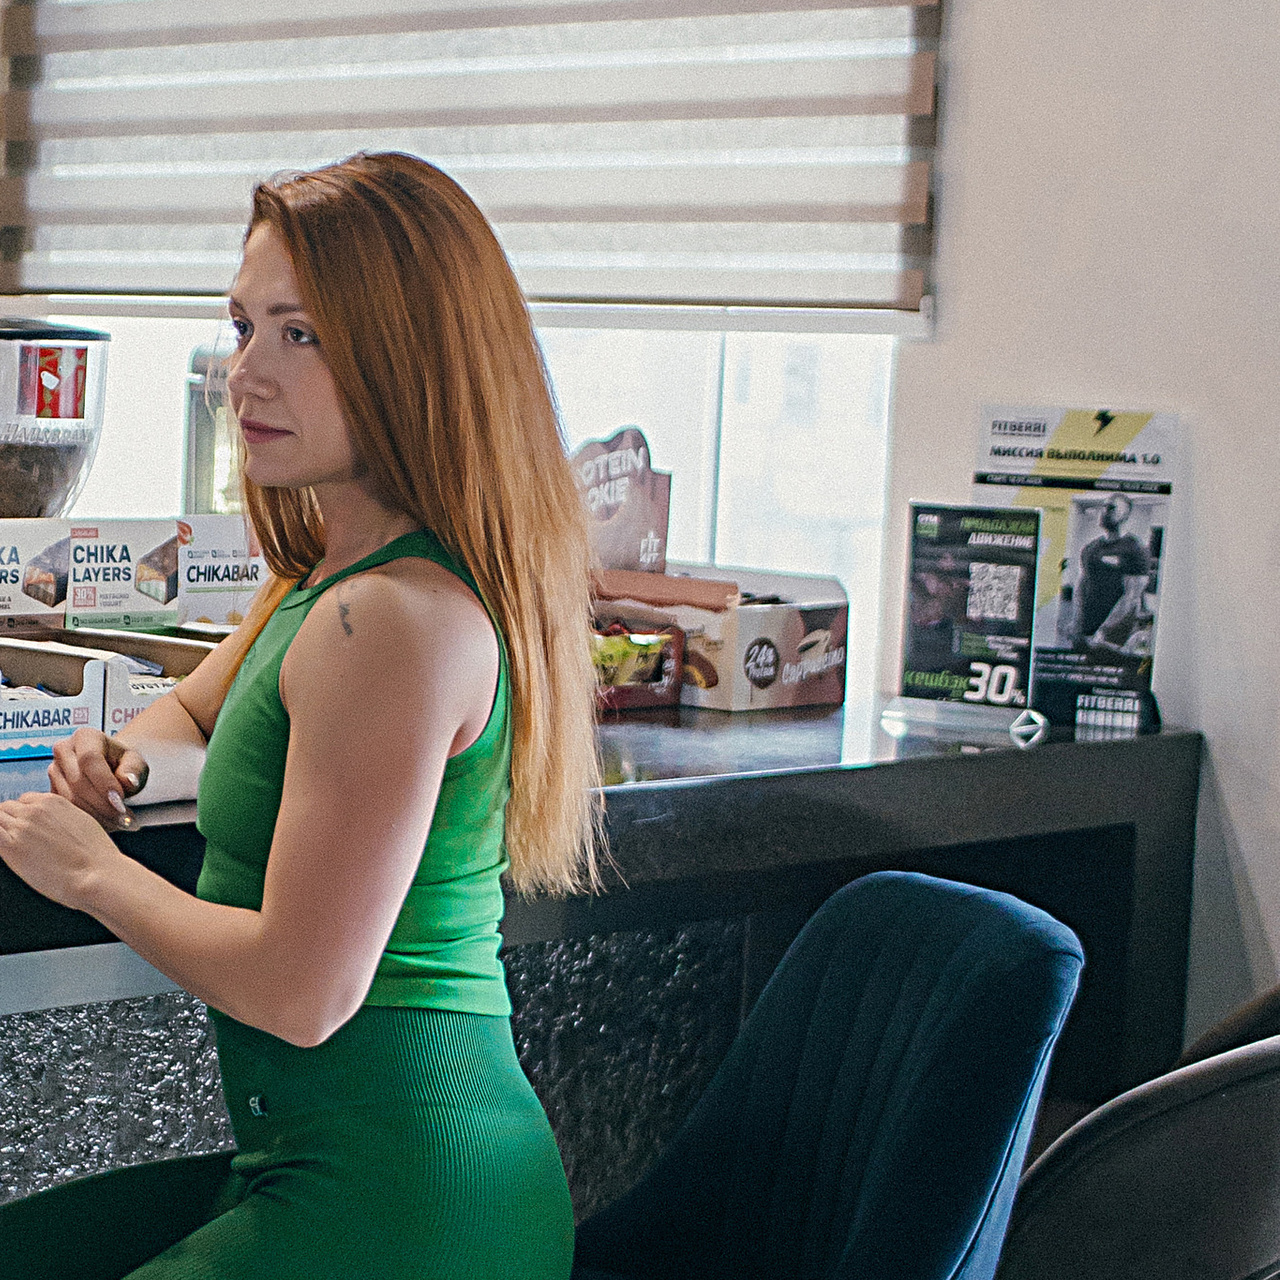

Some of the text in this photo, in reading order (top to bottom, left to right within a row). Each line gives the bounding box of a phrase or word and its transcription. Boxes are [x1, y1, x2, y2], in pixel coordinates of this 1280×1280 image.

[73, 545, 131, 563] CHIKA
[73, 567, 131, 582] LAYERS
[186, 564, 259, 583] CHIKABAR
